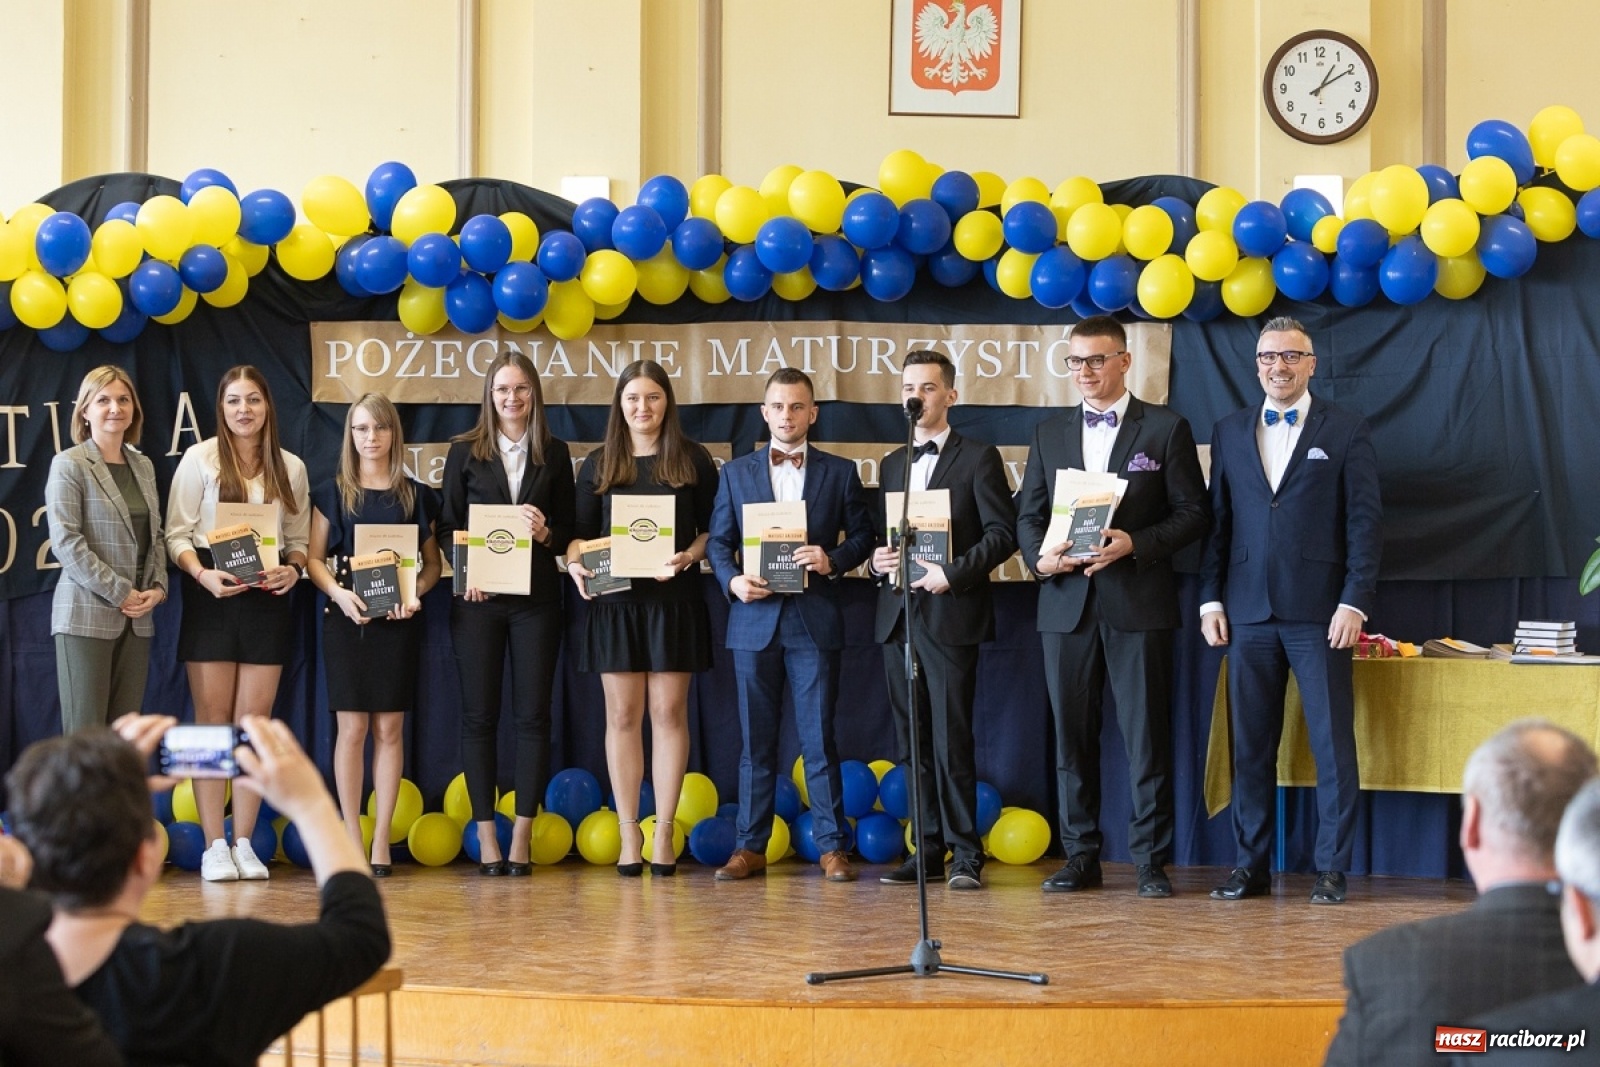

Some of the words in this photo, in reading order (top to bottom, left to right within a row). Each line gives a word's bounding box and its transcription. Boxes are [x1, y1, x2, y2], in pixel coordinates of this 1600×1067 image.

[1297, 52, 1308, 63] 11
[1315, 46, 1325, 58] 12
[1336, 51, 1341, 62] 1
[1284, 65, 1295, 77] 10
[1347, 63, 1355, 75] 2
[1279, 83, 1287, 94] 9
[1354, 81, 1362, 92] 3
[1287, 100, 1294, 112] 8
[1348, 99, 1356, 111] 4
[1300, 113, 1308, 125] 7
[1318, 117, 1325, 128] 6
[1335, 112, 1344, 124] 5
